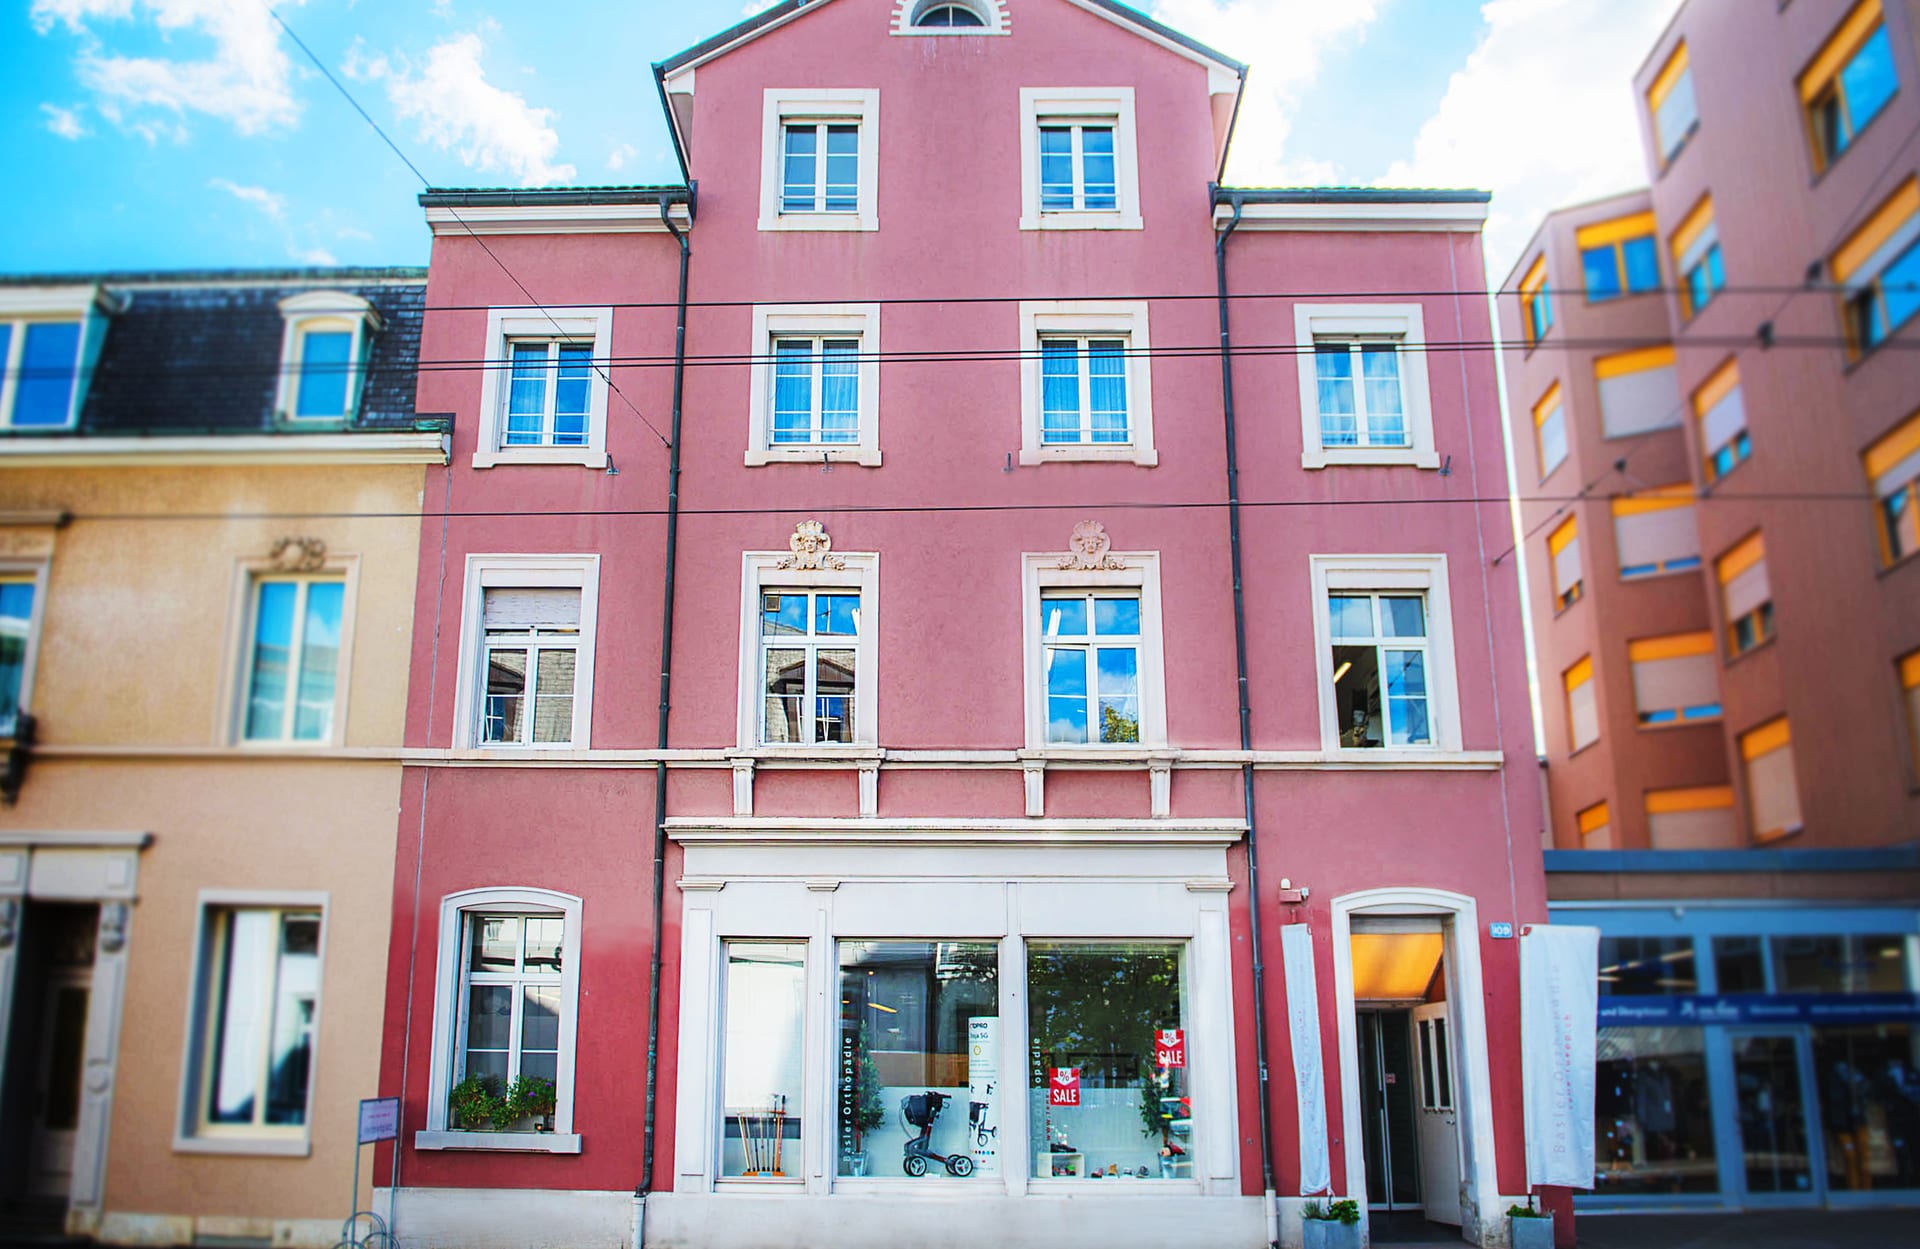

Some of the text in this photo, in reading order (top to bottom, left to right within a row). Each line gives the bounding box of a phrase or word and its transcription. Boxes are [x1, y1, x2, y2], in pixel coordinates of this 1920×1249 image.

[1158, 1050, 1183, 1065] SALE
[842, 1036, 853, 1162] Basler Orthopädie
[1053, 1088, 1077, 1103] SALE
